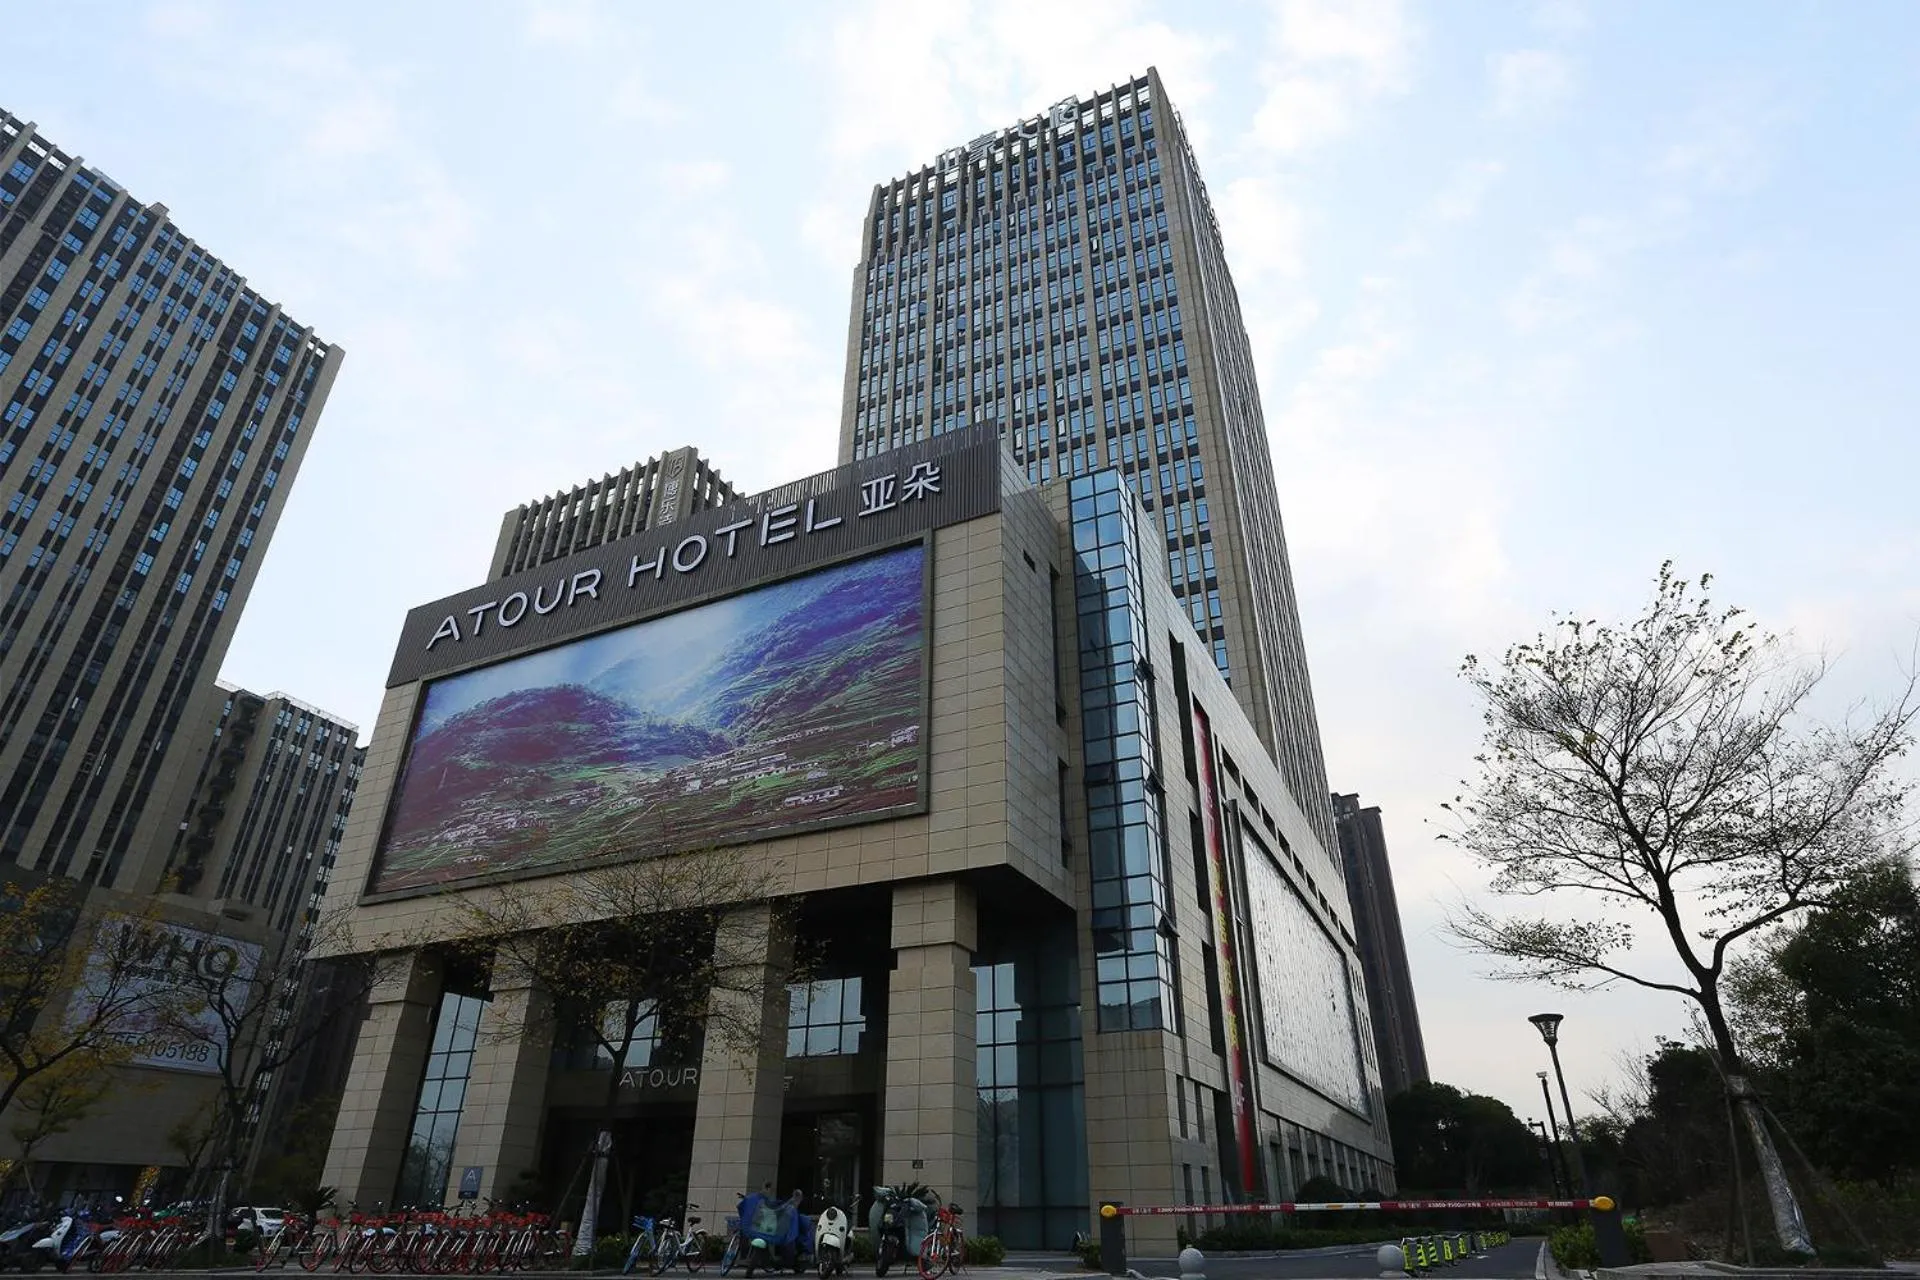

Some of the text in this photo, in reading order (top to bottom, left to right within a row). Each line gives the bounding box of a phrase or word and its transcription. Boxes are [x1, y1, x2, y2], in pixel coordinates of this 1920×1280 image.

[425, 462, 942, 650] ATOUR HOTEL 亚朵
[619, 1067, 698, 1089] ATOUR
